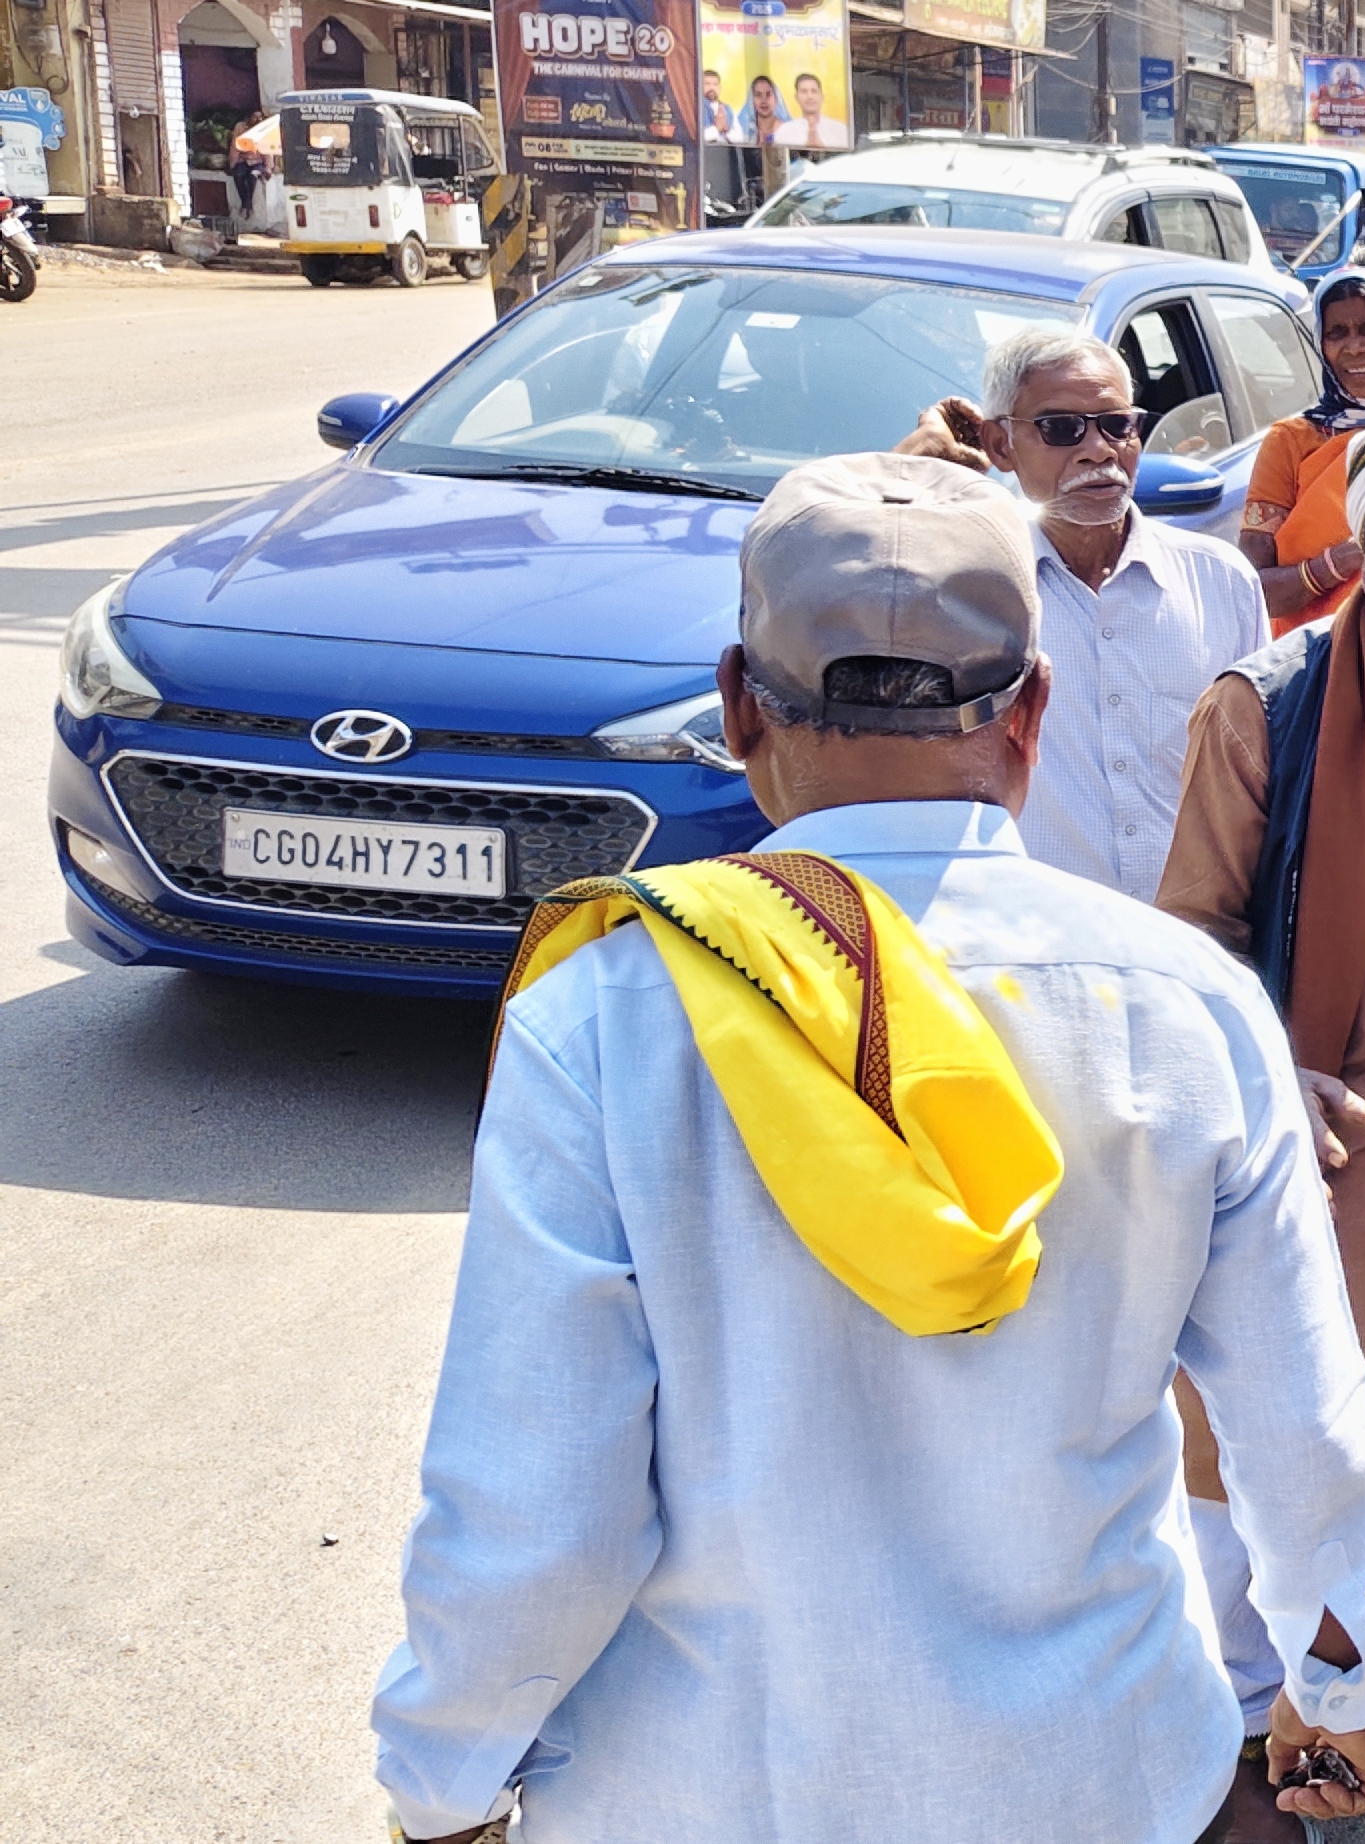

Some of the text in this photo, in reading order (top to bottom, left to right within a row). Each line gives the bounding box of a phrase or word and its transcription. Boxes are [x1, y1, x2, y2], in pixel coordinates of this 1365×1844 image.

[520, 13, 673, 60] HOPE 2.0
[533, 61, 666, 82] THE CARNIVAL FOR CHARITY
[253, 827, 494, 883] CG04HY7311
